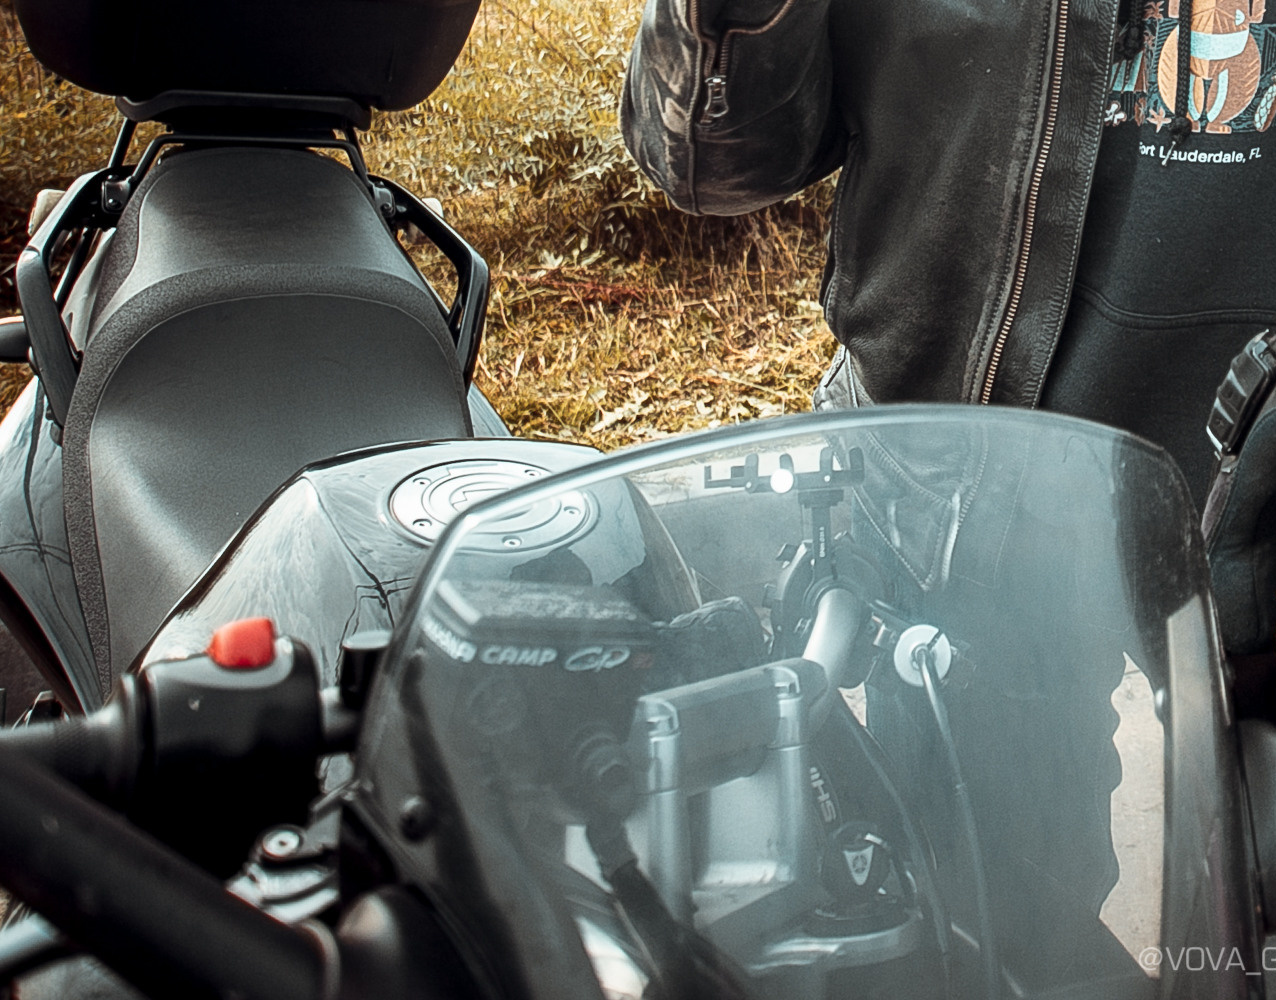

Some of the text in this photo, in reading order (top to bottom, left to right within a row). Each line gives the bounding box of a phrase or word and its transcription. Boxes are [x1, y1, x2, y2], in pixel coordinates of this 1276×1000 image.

[1159, 146, 1246, 163] Lauderdale,
[1249, 147, 1262, 160] FL
[479, 645, 557, 667] CAMP
